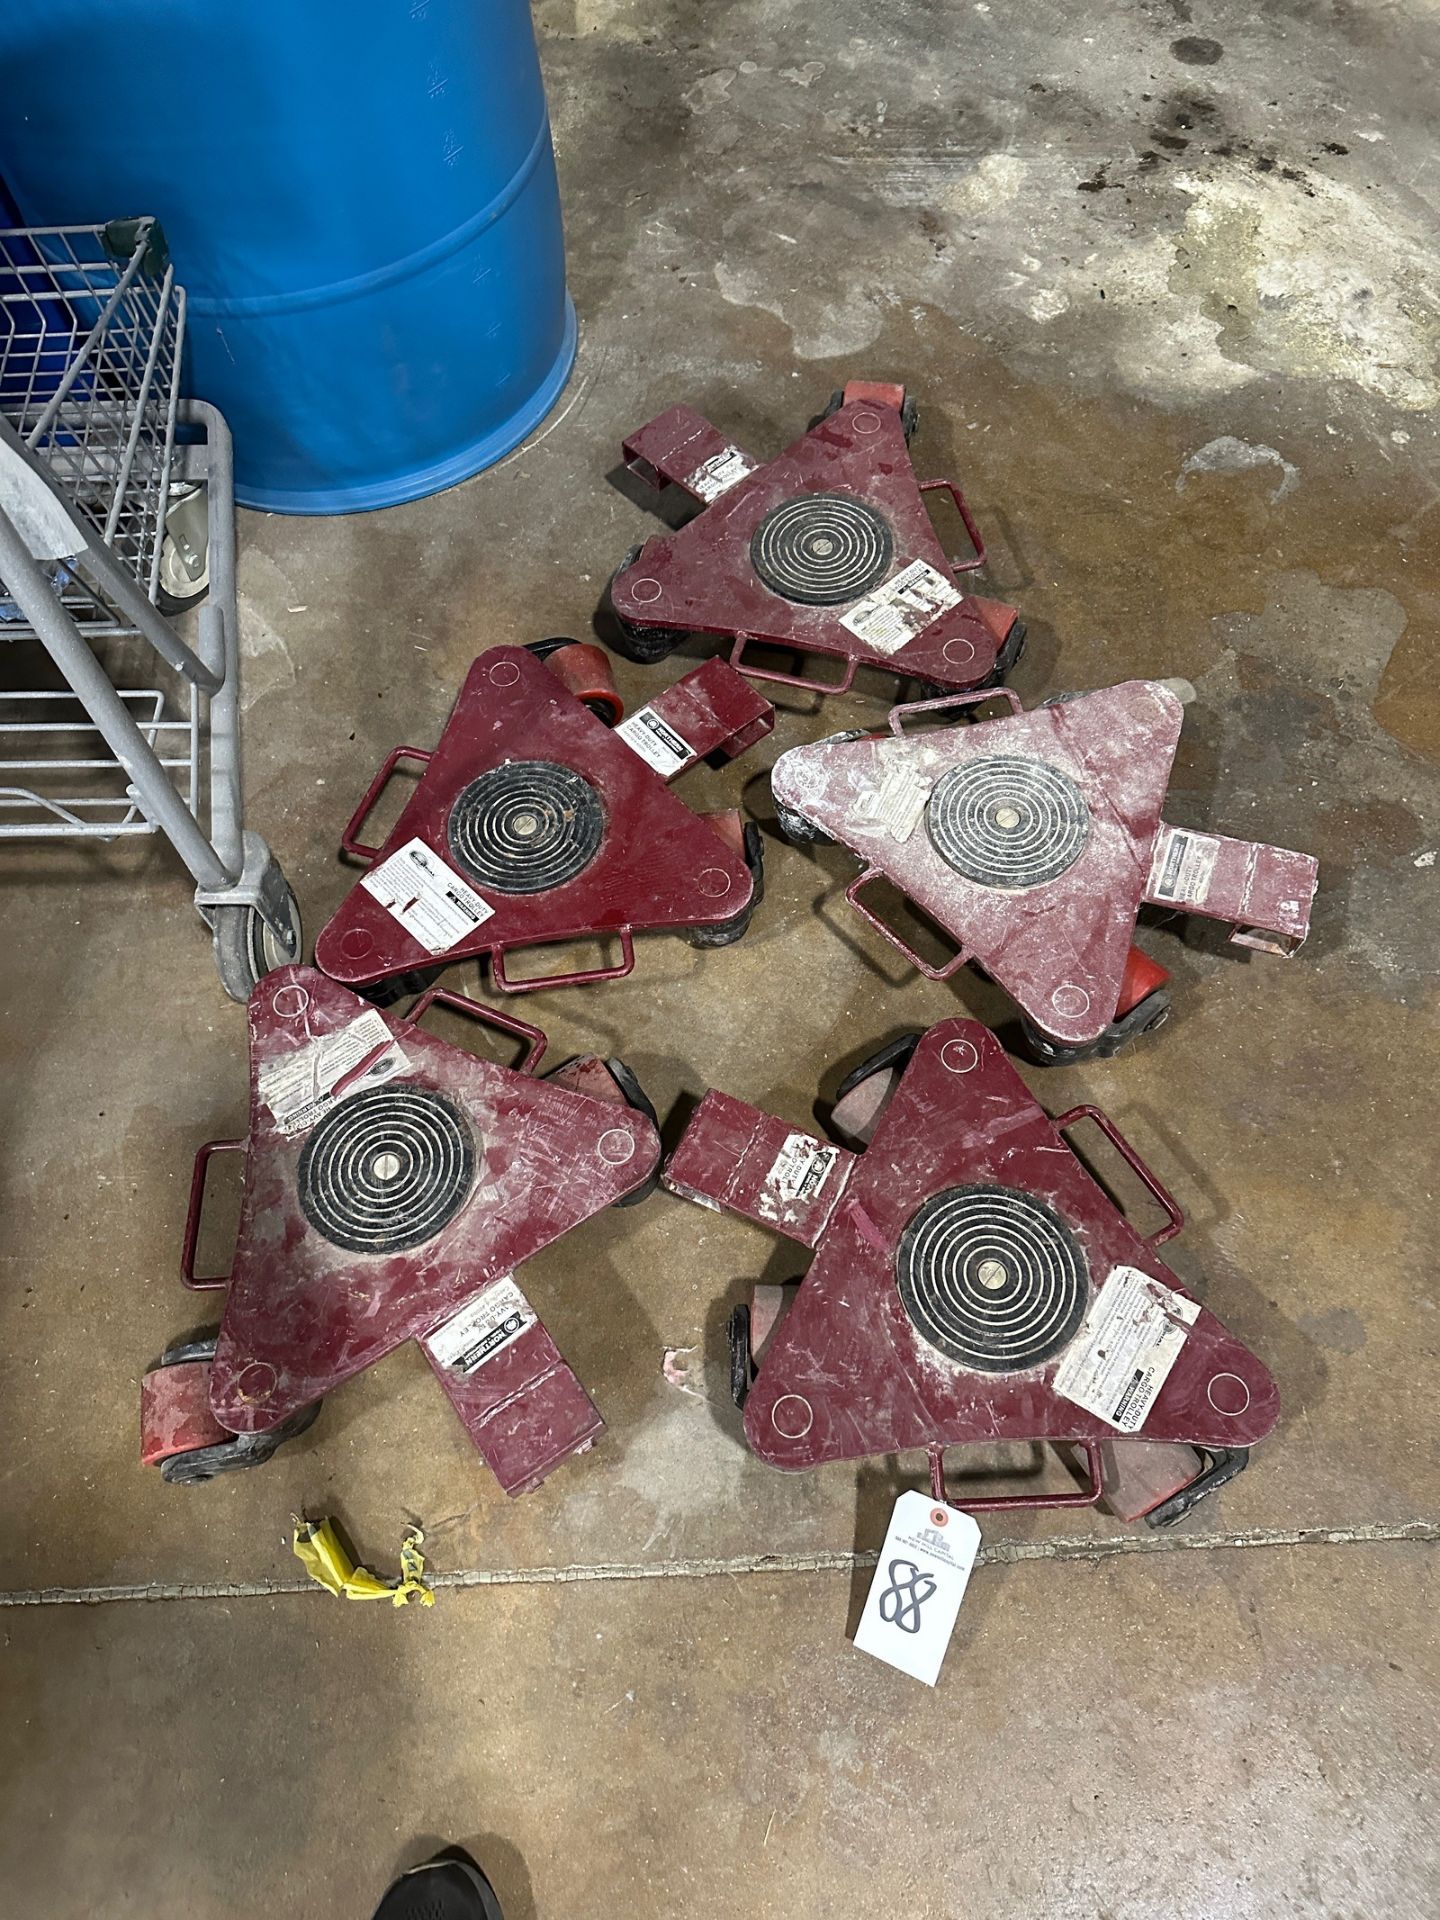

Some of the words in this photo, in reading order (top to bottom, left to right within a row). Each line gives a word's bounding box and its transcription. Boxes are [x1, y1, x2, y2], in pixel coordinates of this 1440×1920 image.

[625, 724, 642, 740] CARGO
[640, 738, 660, 758] TROLLEY
[656, 725, 684, 752] NORTHERN
[446, 881, 464, 899] CARGO
[462, 897, 484, 918] TROLLEY
[1186, 881, 1195, 897] ARGO
[455, 900, 476, 920] WARNING
[464, 1329, 506, 1366] NORTHERN
[1137, 1365, 1155, 1393] CARGO
[1115, 1386, 1134, 1417] WARNING
[1120, 1392, 1141, 1426] TROLLEY
[879, 1558, 938, 1634] 88
